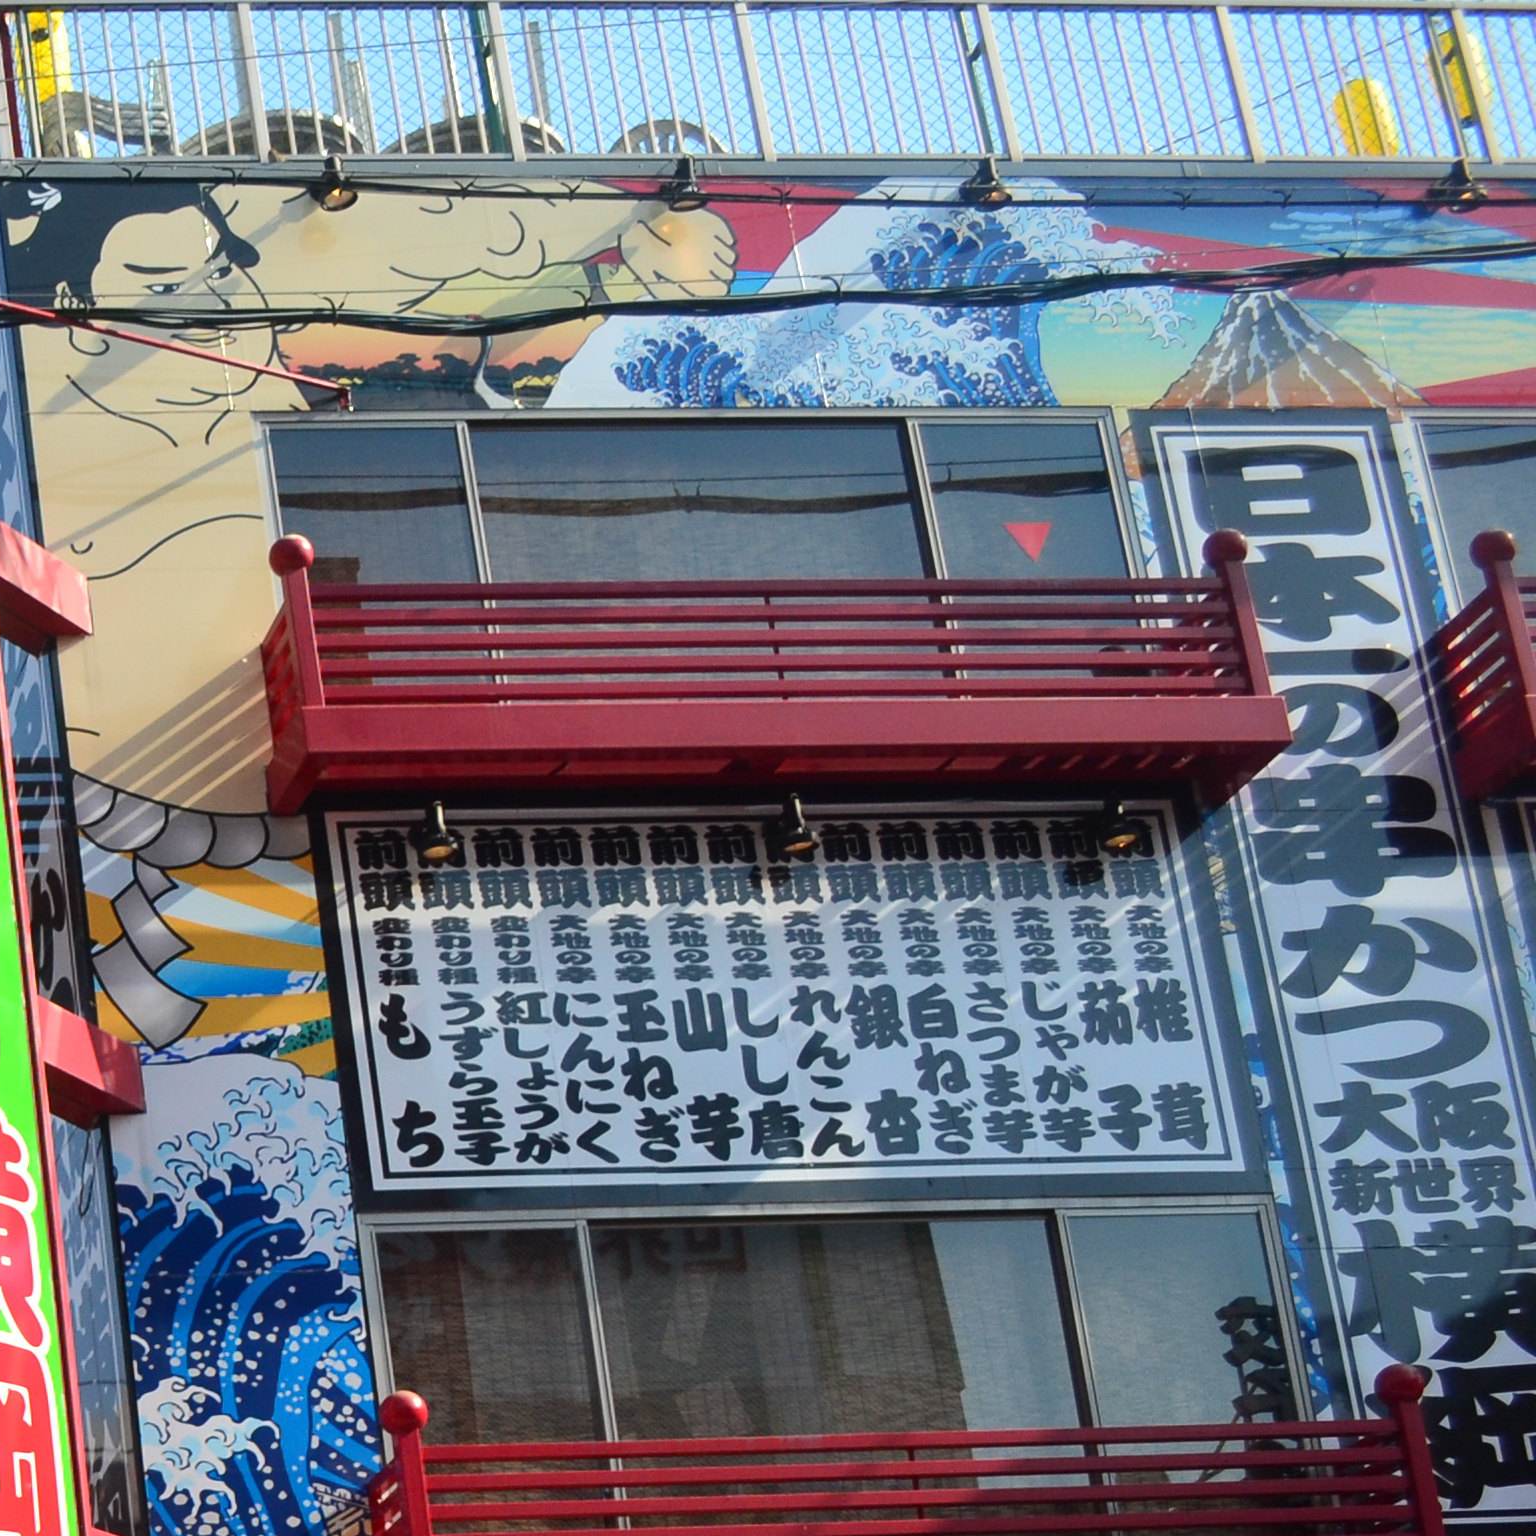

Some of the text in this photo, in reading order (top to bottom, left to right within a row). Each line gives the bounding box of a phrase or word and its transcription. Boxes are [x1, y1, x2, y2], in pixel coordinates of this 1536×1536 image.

[1183, 445, 1491, 1080] 日本一の串かつ
[530, 826, 593, 908] 前頭
[588, 825, 651, 908] 前頭
[646, 825, 709, 907] 前頭
[704, 824, 766, 907] 前頭
[820, 821, 881, 903] 前頭
[876, 820, 939, 902] 前頭
[989, 819, 1053, 901] 前頭
[1046, 818, 1109, 901] 前頭
[355, 829, 446, 1169] 前頭 変わり種 もち
[431, 916, 479, 985] 変わり種
[473, 826, 571, 1164] 前頭 変わり種 紅しょうが
[932, 819, 996, 902] 前頭
[965, 981, 1038, 1154] さつま芋
[438, 991, 512, 1167] うずら玉子
[552, 992, 622, 1165] にんにく
[613, 989, 685, 1163] 玉ねぎ
[671, 987, 745, 1161] 山芋
[730, 986, 805, 1160] しし唐
[789, 984, 866, 1158] れんこん
[844, 983, 923, 1157] 銀杏
[907, 982, 978, 1155] 白ねぎ
[1020, 980, 1096, 1154] じゃが芋
[1077, 979, 1153, 1152] 茄子
[1133, 978, 1210, 1152] 椎茸
[1314, 1081, 1518, 1153] 大阪
[1329, 1155, 1528, 1216] 新世界
